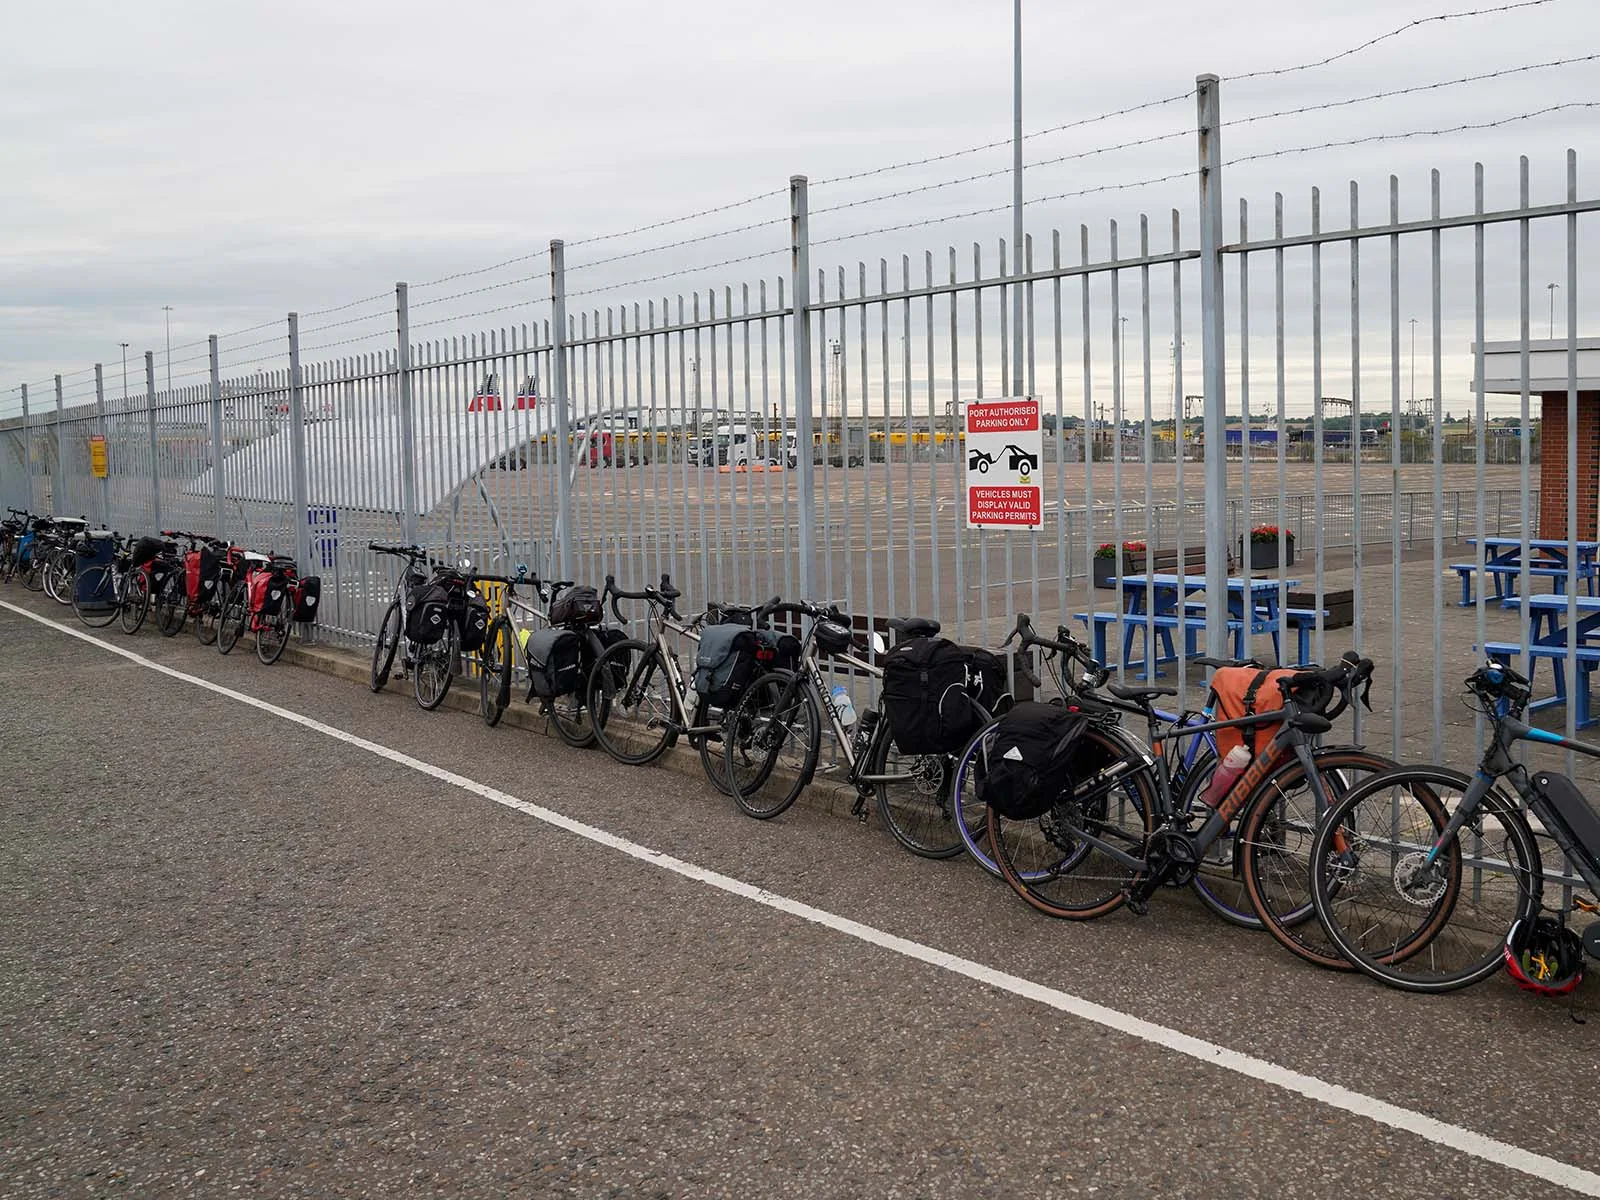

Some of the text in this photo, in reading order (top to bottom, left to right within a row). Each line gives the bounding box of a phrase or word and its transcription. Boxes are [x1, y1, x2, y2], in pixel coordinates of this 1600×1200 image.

[969, 406, 1037, 418] PORT AUTHORISED
[976, 418, 1029, 428] PARKING ONLY
[976, 490, 1032, 499] VEHICLES MUST
[977, 501, 1031, 510] DISPLAY VALID
[972, 511, 1037, 521] PARKING PERMITS
[812, 671, 838, 719] SONDER
[1218, 742, 1281, 821] RIBBLE
